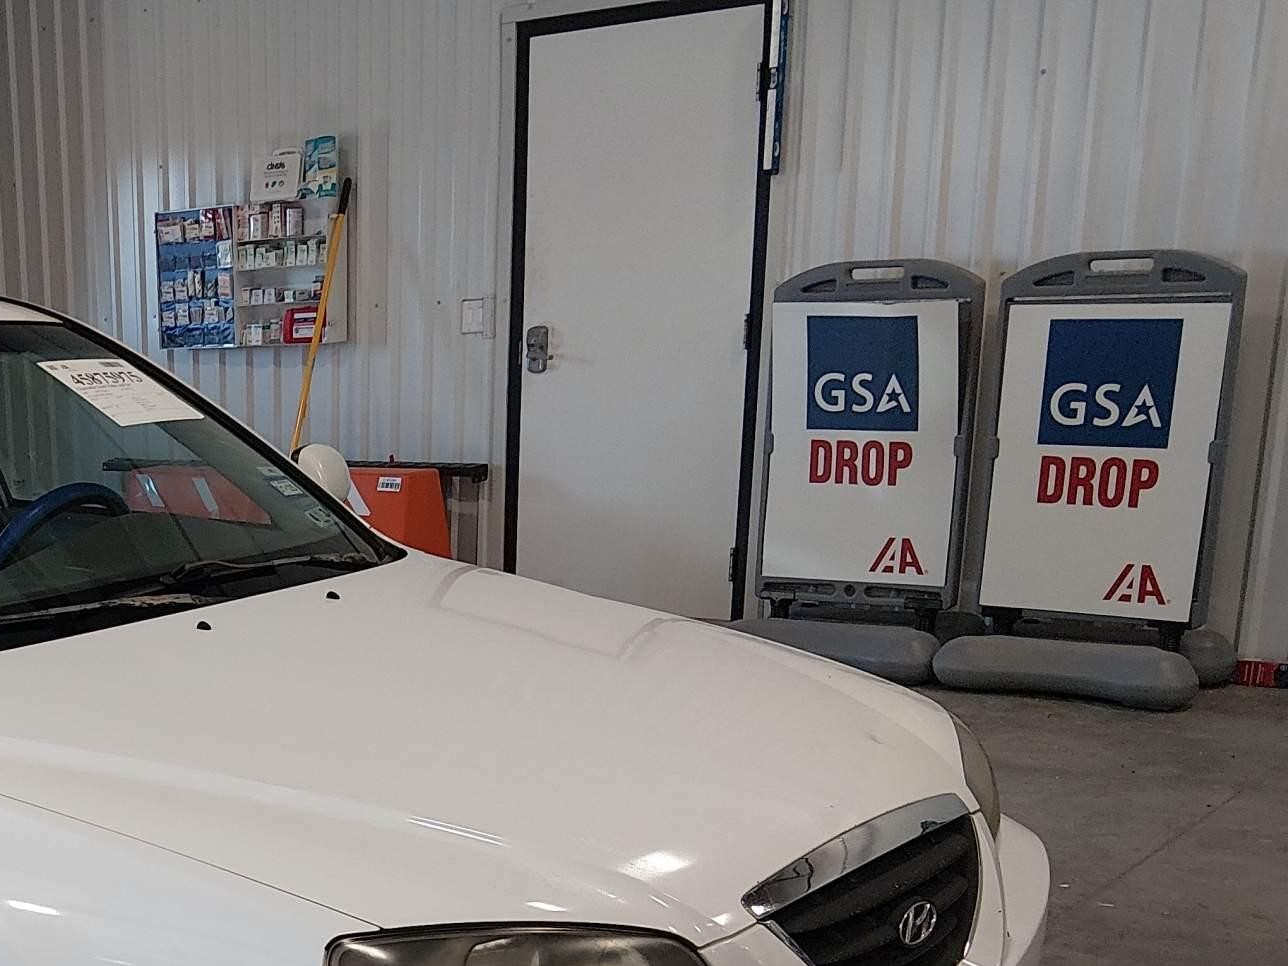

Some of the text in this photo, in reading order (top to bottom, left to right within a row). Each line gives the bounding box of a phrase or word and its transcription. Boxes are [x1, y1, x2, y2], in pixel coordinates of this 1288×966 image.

[70, 370, 144, 387] 45875975
[814, 372, 912, 413] GSA
[1049, 382, 1162, 428] GSA
[808, 439, 913, 487] DROP
[1036, 455, 1160, 509] DROP
